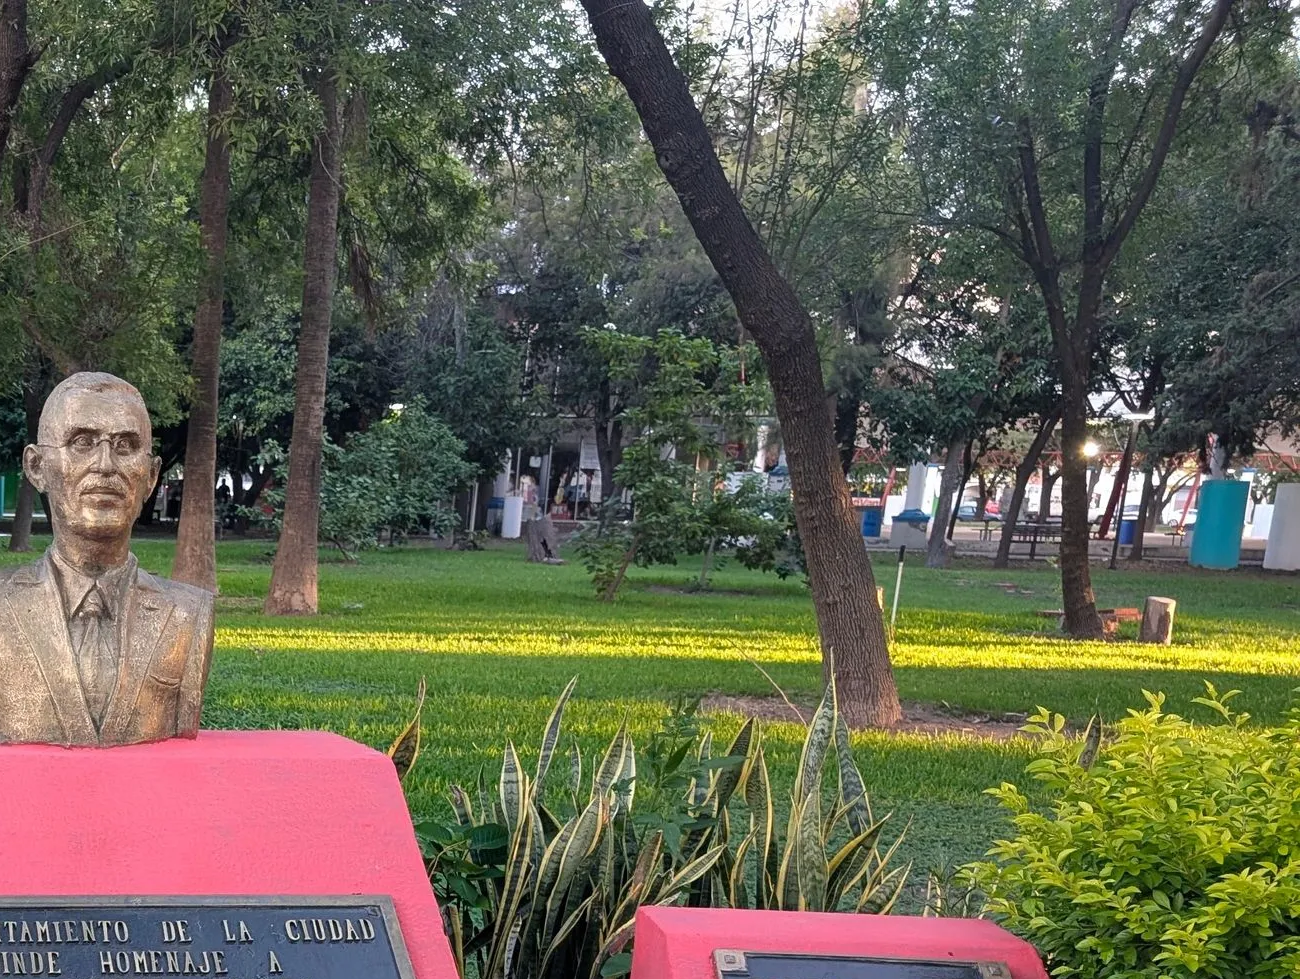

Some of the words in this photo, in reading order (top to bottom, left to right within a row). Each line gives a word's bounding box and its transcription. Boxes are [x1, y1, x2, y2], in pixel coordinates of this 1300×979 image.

[163, 920, 192, 942] DE
[223, 919, 253, 941] LA
[285, 918, 375, 941] CIUDAD
[100, 951, 228, 974] HOMENAJE
[269, 951, 283, 973] A
